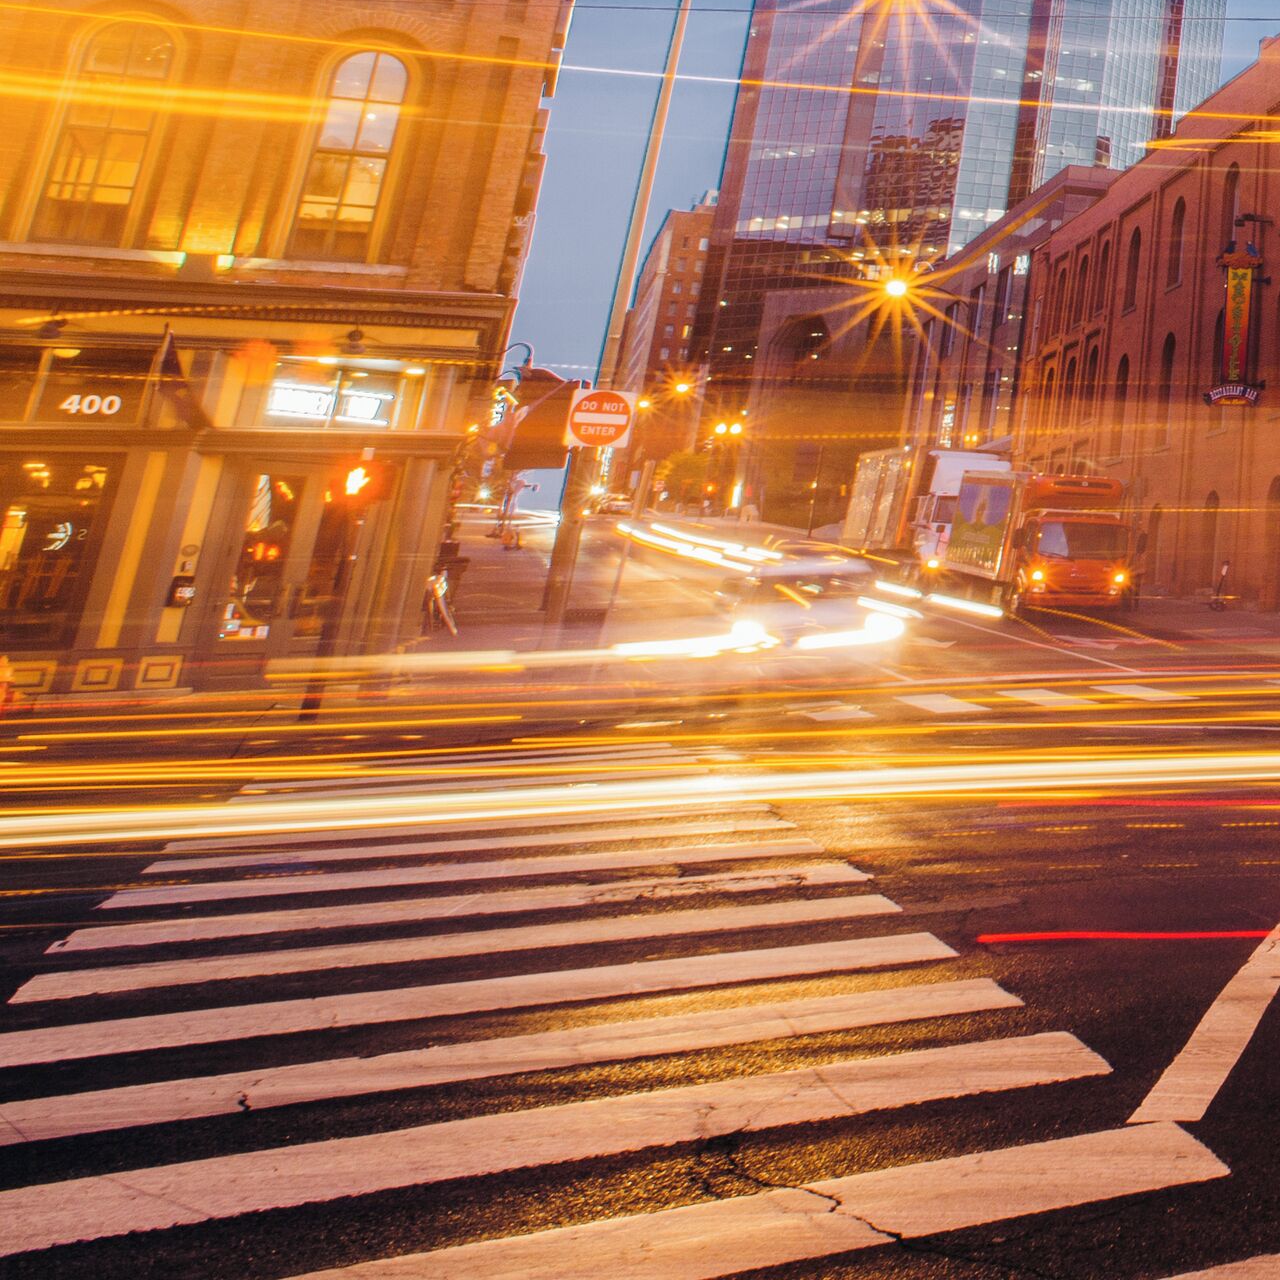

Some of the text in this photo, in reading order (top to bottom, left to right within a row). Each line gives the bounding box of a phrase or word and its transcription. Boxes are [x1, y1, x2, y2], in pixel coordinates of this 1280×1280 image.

[59, 394, 122, 415] 400
[582, 400, 625, 412] DO NOT
[580, 425, 616, 436] ENTER
